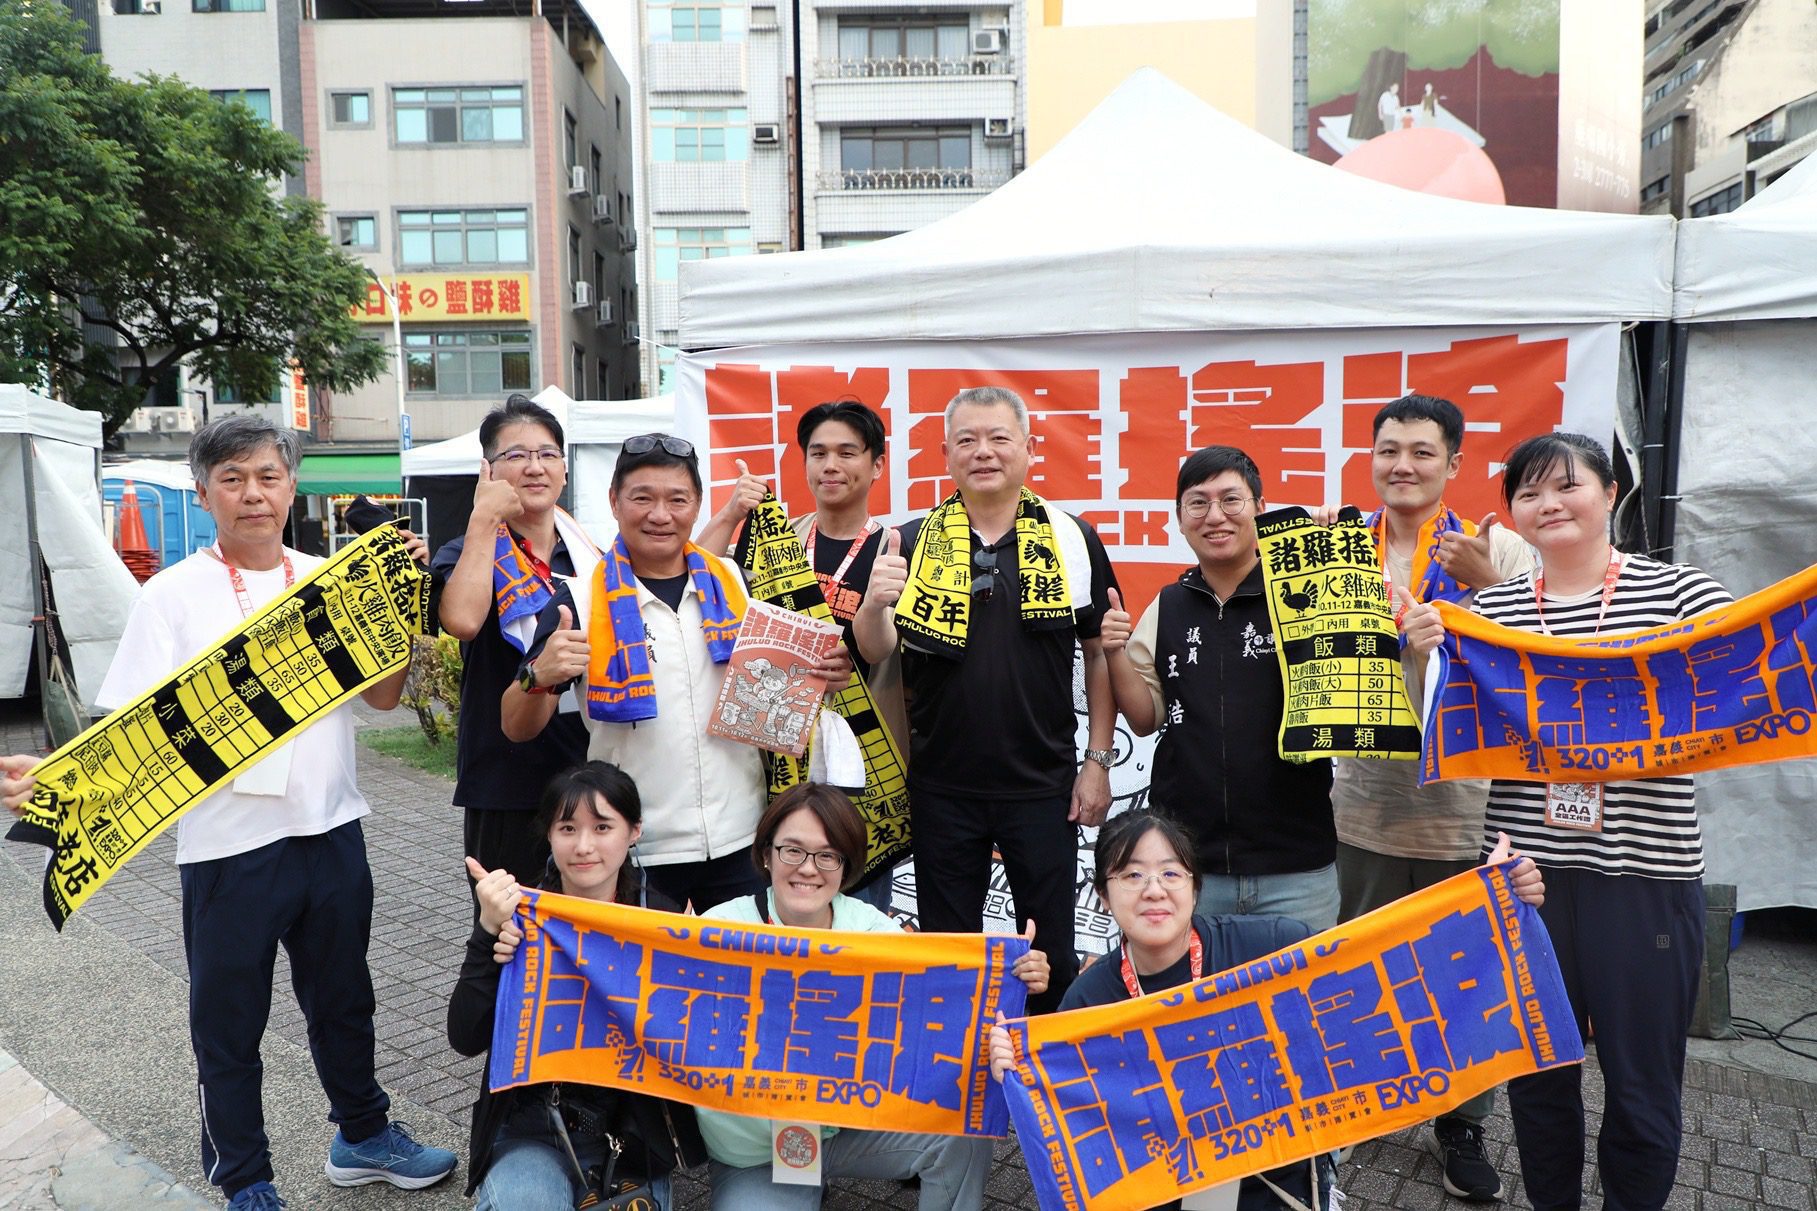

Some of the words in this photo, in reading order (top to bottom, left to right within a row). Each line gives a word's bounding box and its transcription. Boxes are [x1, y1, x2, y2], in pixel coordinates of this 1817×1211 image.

[350, 280, 521, 317] 口味の鹽酥雞
[1077, 510, 1169, 546] CK
[1259, 517, 1313, 536] ESTIVAL
[744, 516, 757, 568] ESTIVAL
[1268, 530, 1380, 576] 諸羅搖
[355, 578, 406, 660] 火雞肉飯
[912, 585, 968, 633] 百年
[1021, 609, 1071, 620] ESTIVAL
[896, 618, 941, 640] JHULUO
[941, 632, 967, 648] ROC
[1327, 618, 1349, 630] 內用
[772, 639, 797, 652] ROCK
[796, 645, 822, 662] FESTI
[1186, 626, 1202, 664] 議員
[1313, 634, 1377, 658] 飯類
[293, 660, 308, 677] 50
[306, 652, 322, 669] 35
[1368, 661, 1384, 673] 35
[266, 676, 284, 693] 35
[281, 669, 296, 685] 65
[1368, 677, 1384, 689] 50
[629, 684, 656, 699] ROC
[1367, 694, 1383, 706] 65
[214, 711, 231, 728] 30
[228, 702, 245, 718] 20
[1367, 711, 1382, 722] 35
[200, 722, 217, 738] 20
[1312, 727, 1375, 748] 湯類
[1734, 709, 1812, 745] EXPO
[149, 761, 164, 777] 15
[162, 750, 179, 766] 60
[1556, 803, 1591, 816] AAA
[1488, 866, 1522, 951] FESTIVAL
[699, 926, 811, 958] CHIAYI
[523, 946, 540, 994] ROCK
[1193, 948, 1309, 1003] CHIAYI
[1515, 951, 1536, 997] ROCK
[512, 998, 534, 1079] FESTIVAL
[969, 1070, 988, 1131] JHULUO
[983, 941, 1005, 1018] FESTIVAL
[1525, 1000, 1556, 1063] JHULUO
[815, 1079, 882, 1109] EXPO
[1375, 1070, 1450, 1112] EXPO
[1028, 1089, 1057, 1139] ROCK
[1047, 1139, 1081, 1211] FESTIVA
